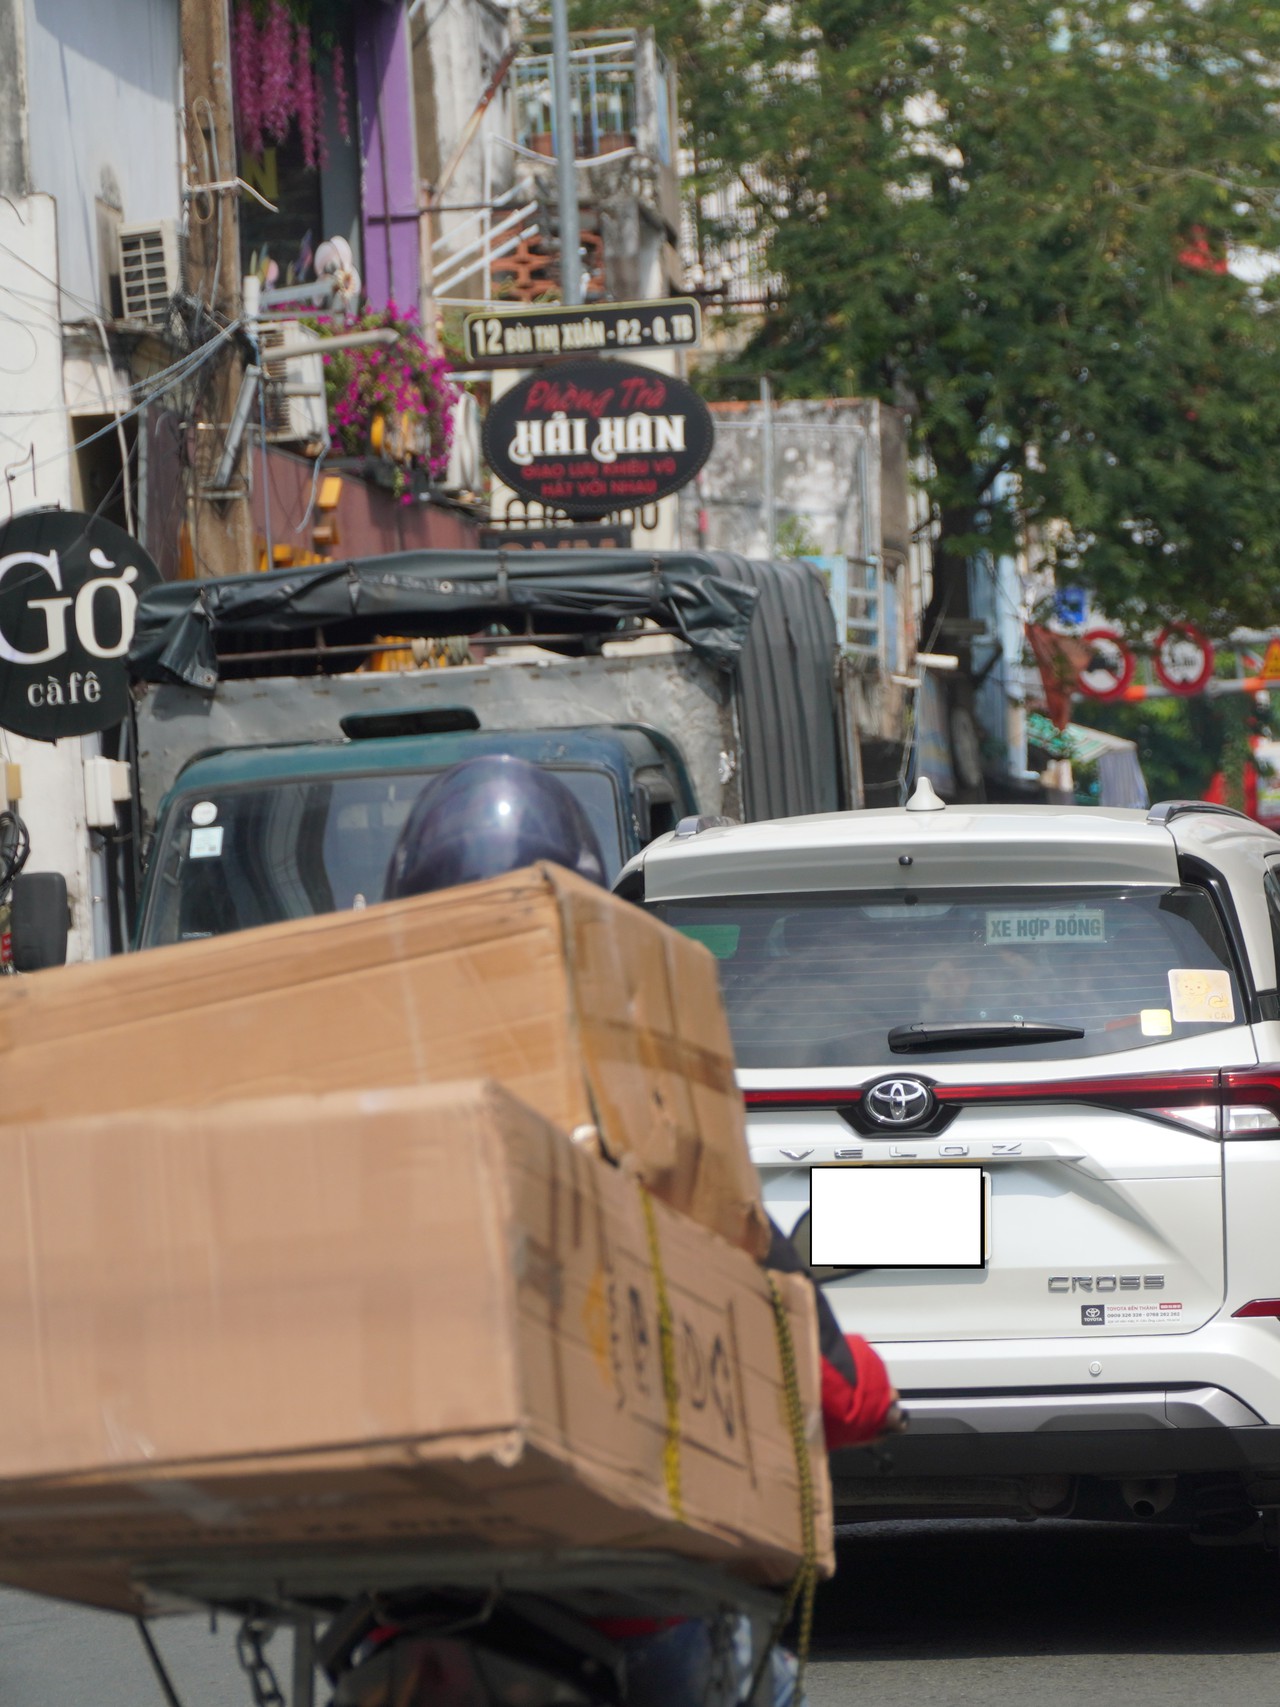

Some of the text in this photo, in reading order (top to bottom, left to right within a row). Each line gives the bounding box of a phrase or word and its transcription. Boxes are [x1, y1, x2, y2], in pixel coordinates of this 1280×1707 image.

[473, 318, 504, 355] 12
[561, 316, 606, 350] XUÂN
[616, 318, 643, 346] P.2
[671, 313, 694, 342] TB
[524, 380, 615, 419] Phòng
[507, 410, 687, 467] HẢI HÂN
[991, 920, 1011, 937] XE
[1016, 917, 1050, 941] HỢP
[779, 1142, 1022, 1161] VELOZ
[1047, 1273, 1165, 1294] CROSS
